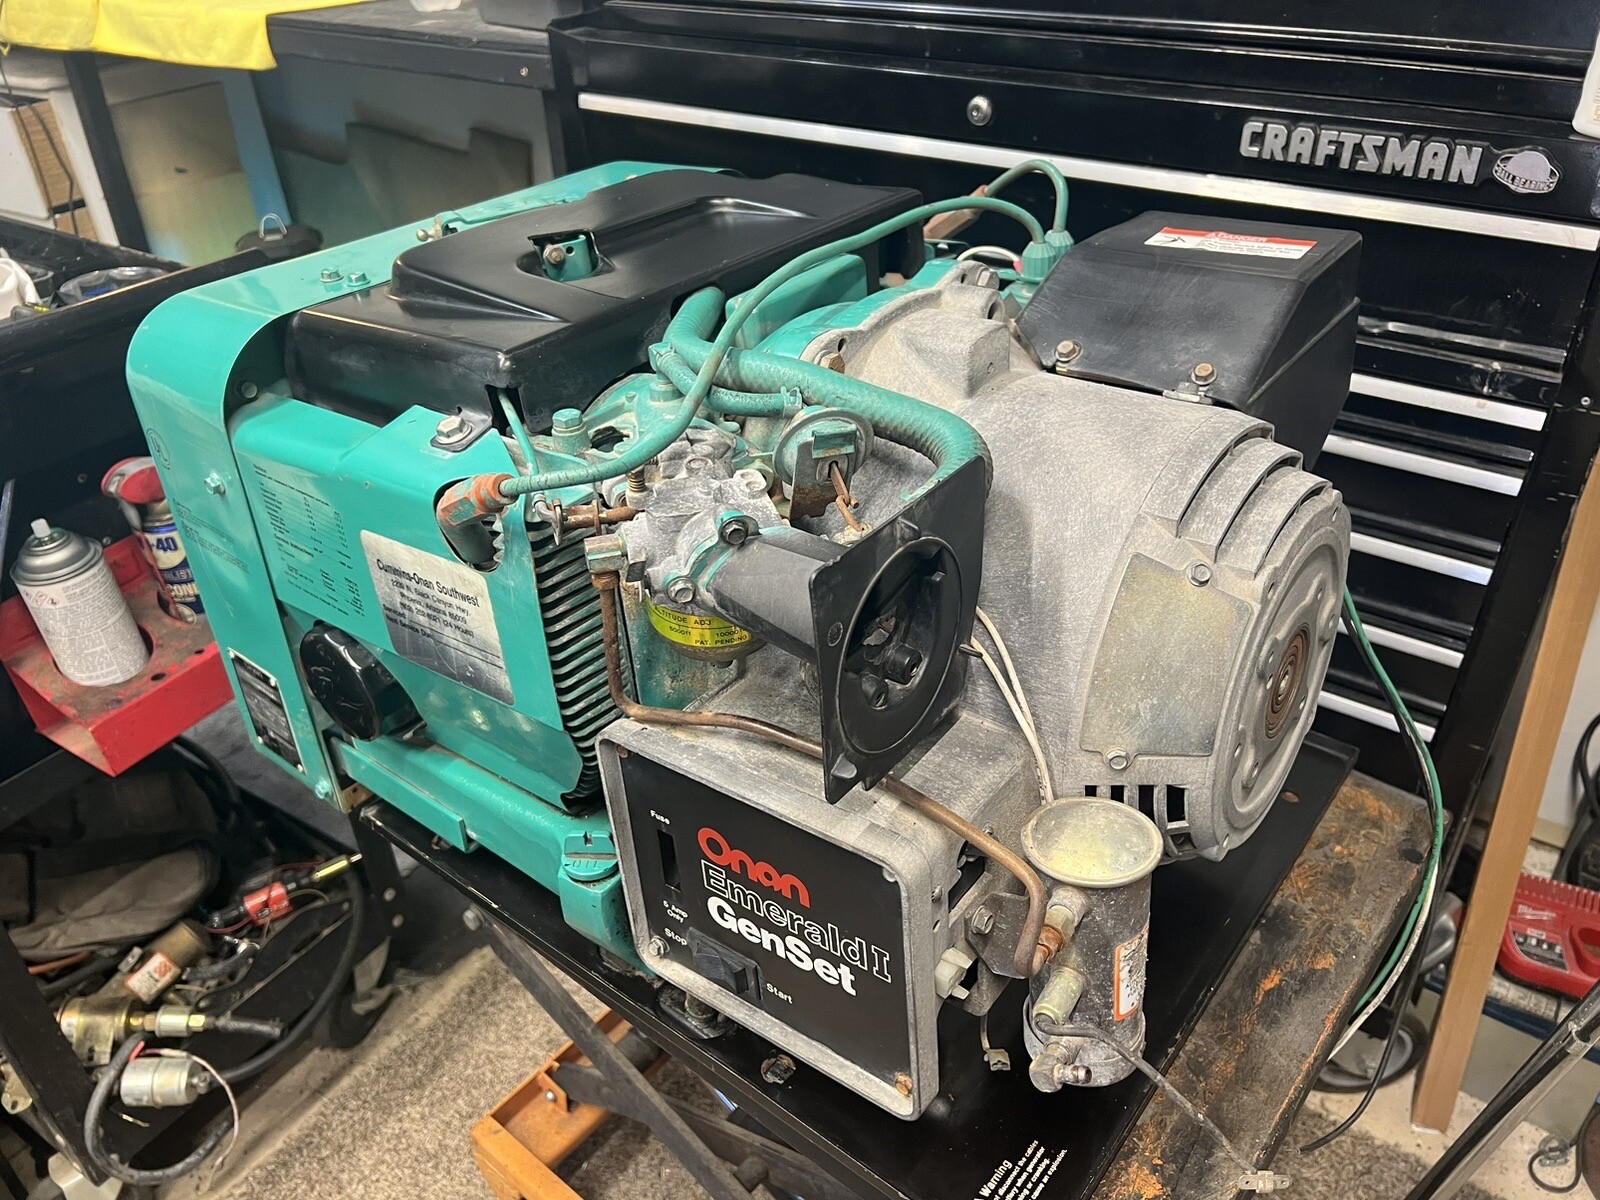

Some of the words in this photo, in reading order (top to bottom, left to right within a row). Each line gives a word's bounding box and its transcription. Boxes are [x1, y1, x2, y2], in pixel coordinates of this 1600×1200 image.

[1239, 121, 1484, 185] CRAFTSMAN
[1215, 232, 1268, 243] DANGER
[377, 559, 435, 591] Cummins-Onan
[436, 581, 480, 608] Southwest
[432, 594, 454, 611] Canyon
[694, 619, 712, 627] ADJ
[715, 634, 748, 645] PENDING
[650, 809, 671, 825] Fuse
[697, 827, 811, 909] Onan
[671, 904, 689, 919] Amp
[701, 859, 868, 971] Emerald
[871, 944, 892, 984] I
[664, 926, 688, 946] Stop
[706, 891, 857, 997] GenSet
[766, 983, 793, 1004] Start
[979, 1159, 1013, 1198] Warning
[998, 1165, 1021, 1197] disconnect
[1017, 1156, 1027, 1167] the
[1024, 1140, 1039, 1158] cables
[1015, 1171, 1029, 1188] when
[1026, 1146, 1046, 1174] generator
[1026, 1181, 1034, 1190] or
[1031, 1158, 1051, 1183] cranking.
[1031, 1182, 1045, 1200] cause
[1042, 1174, 1050, 1184] an
[1047, 1149, 1068, 1177] explosion.
